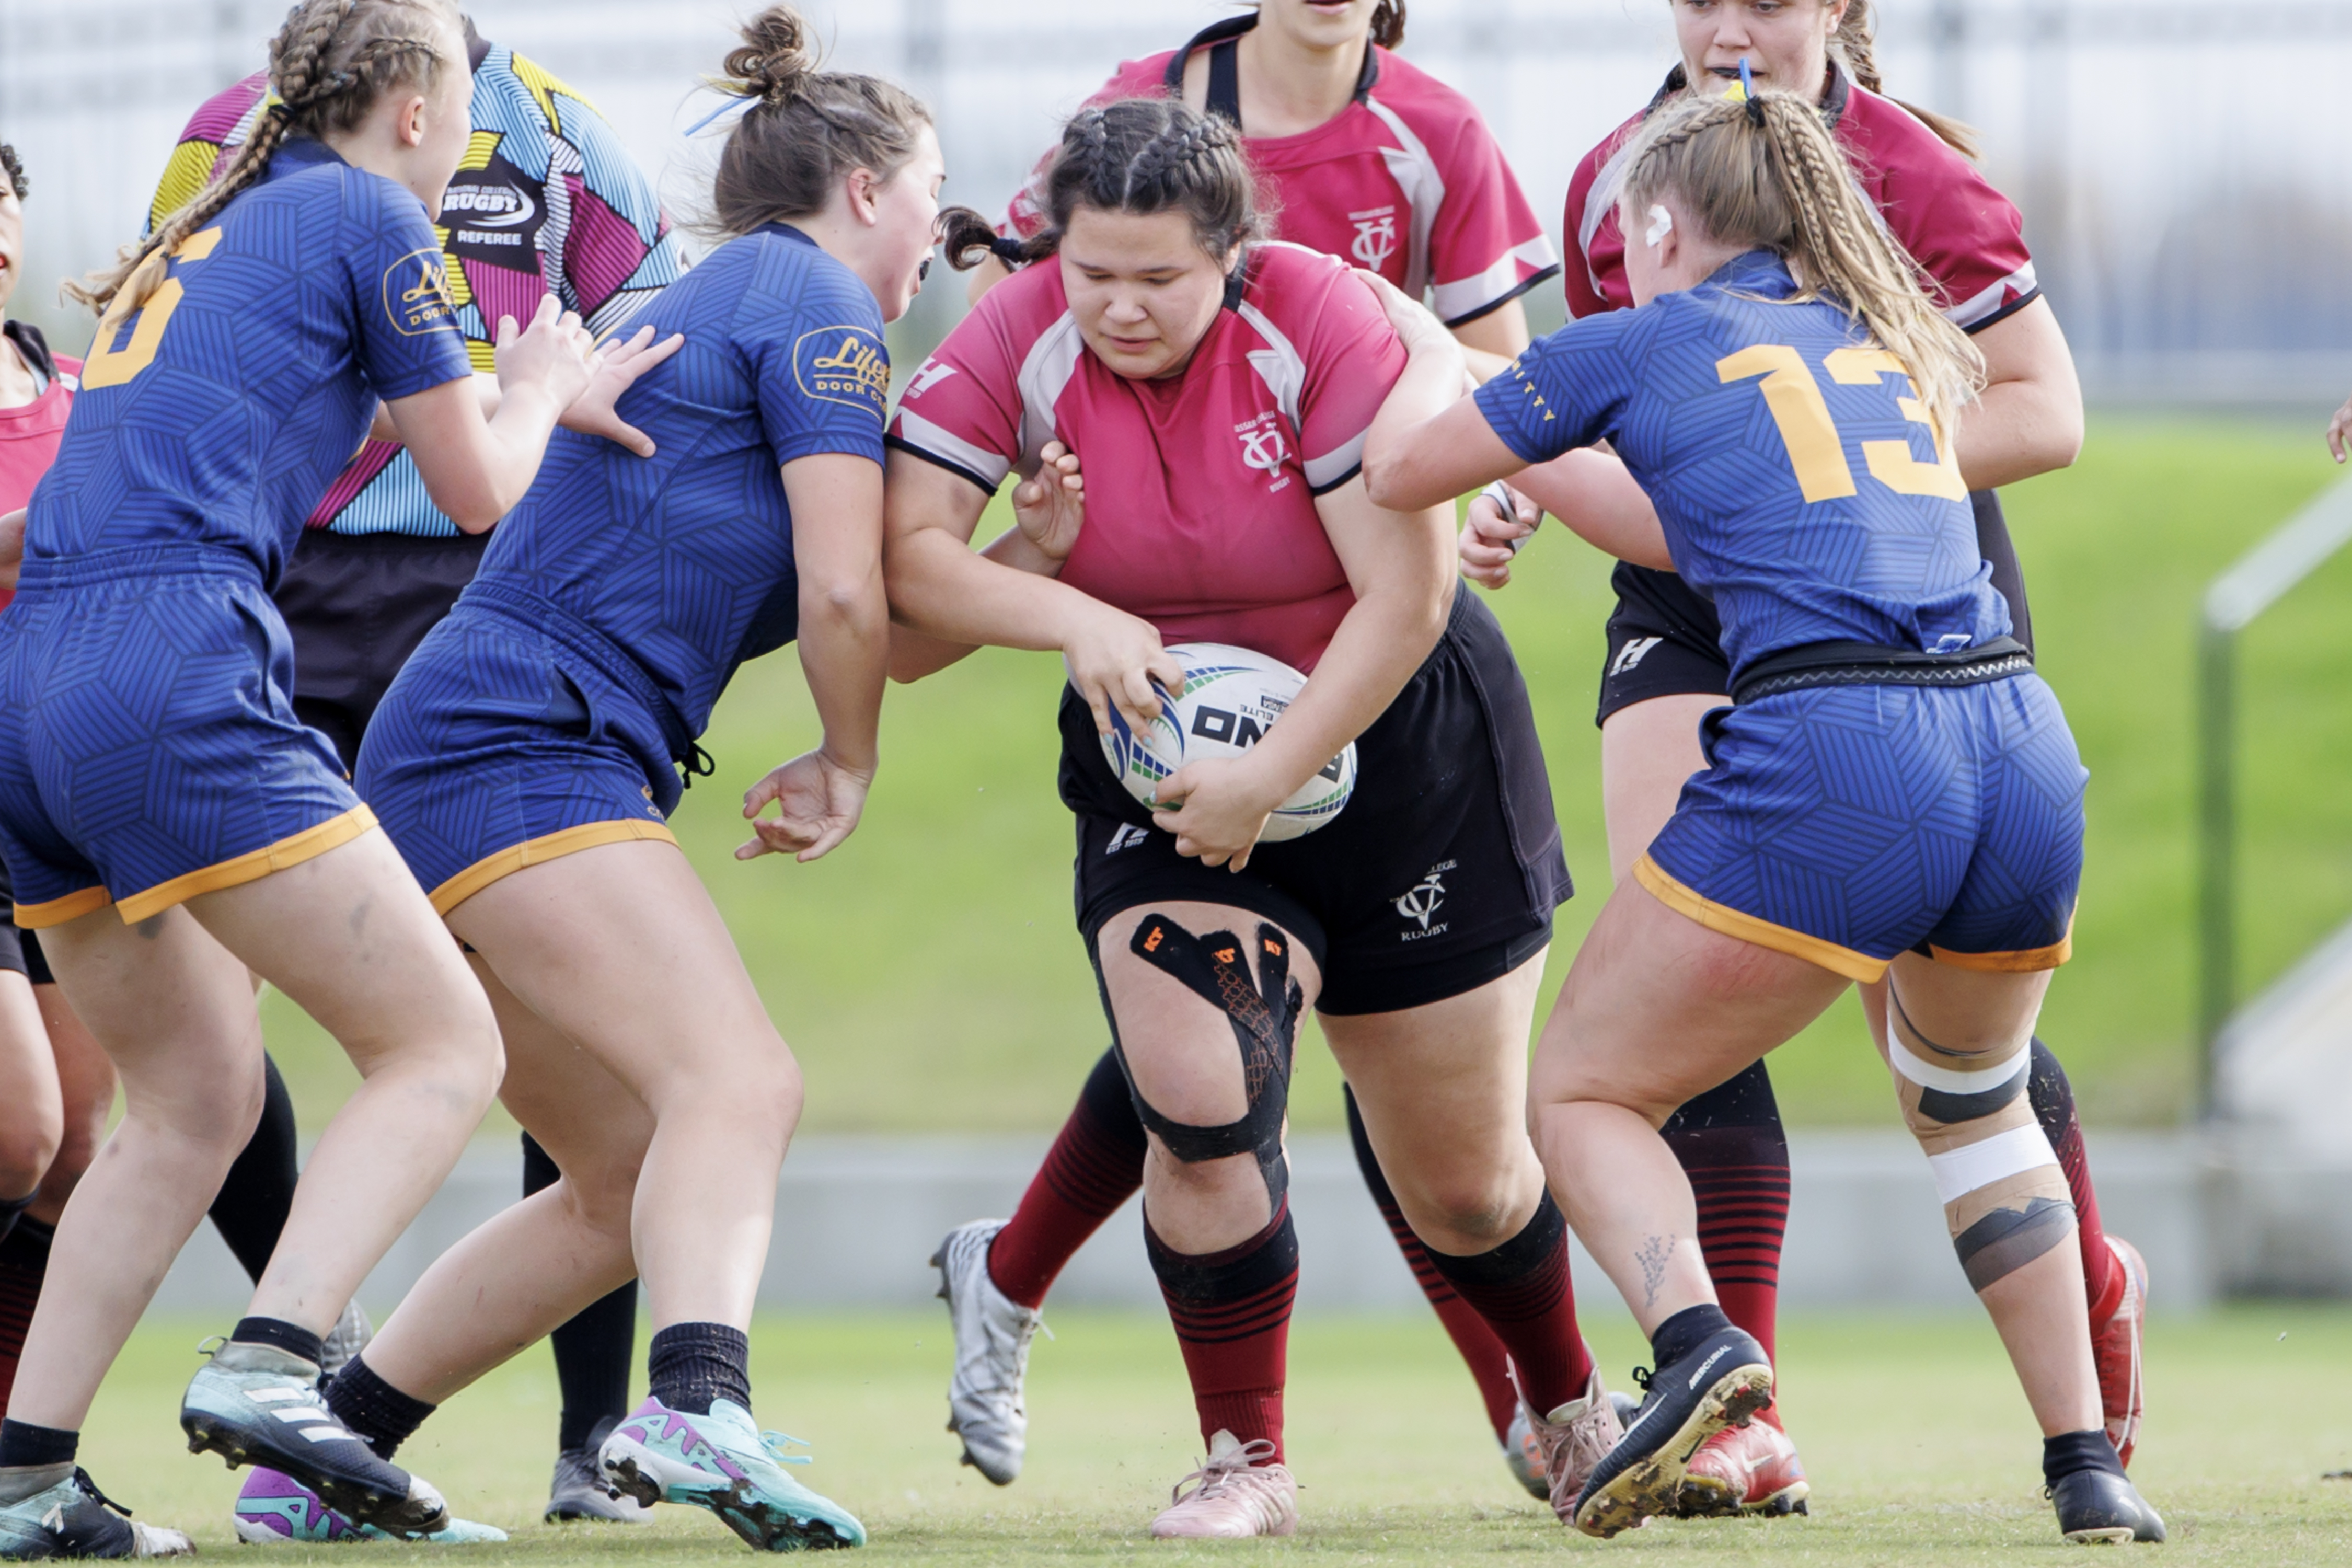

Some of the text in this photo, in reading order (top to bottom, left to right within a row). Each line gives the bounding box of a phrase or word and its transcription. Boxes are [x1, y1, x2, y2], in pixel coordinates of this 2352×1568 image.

[443, 193, 518, 212] RUGBY
[457, 229, 522, 245] REFEREE
[81, 225, 222, 391] 6
[816, 381, 865, 395] DOOR
[1715, 344, 1969, 504] 13
[1239, 704, 1274, 722] ELITE
[1689, 1345, 1732, 1390] MERCURIAL
